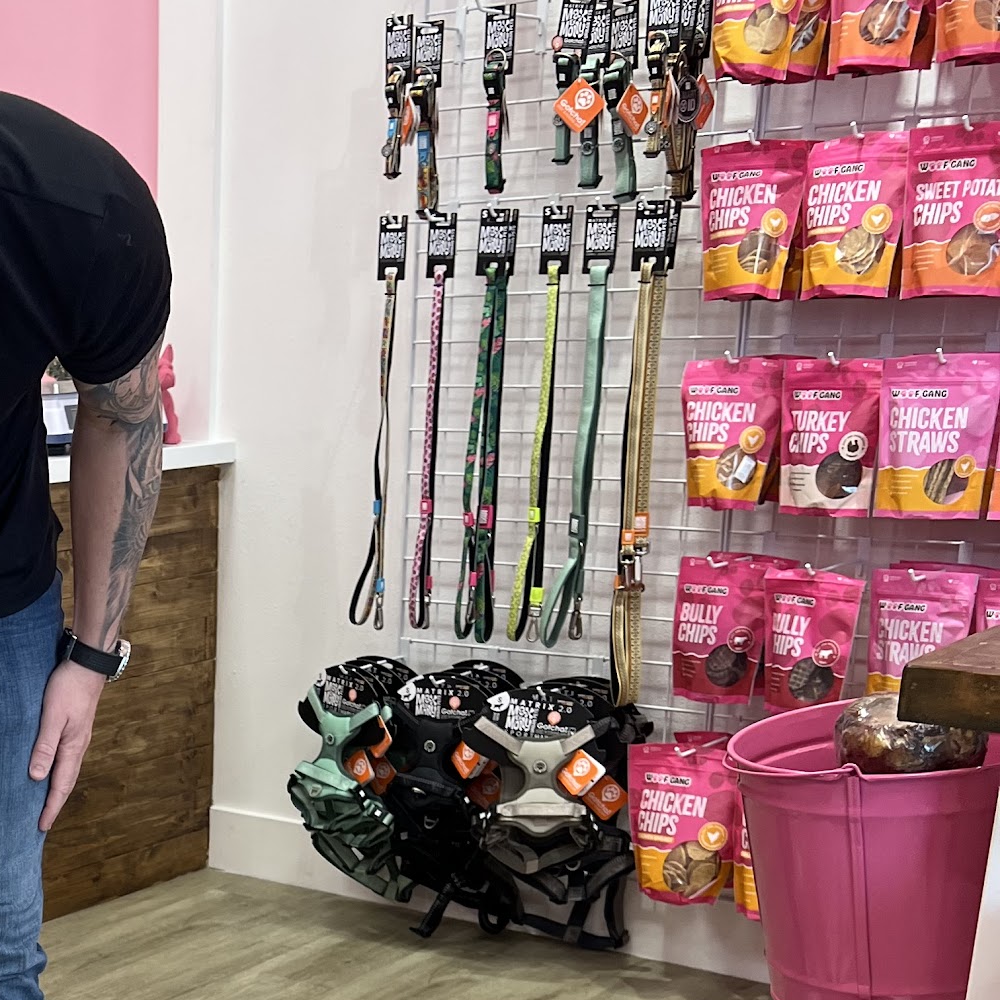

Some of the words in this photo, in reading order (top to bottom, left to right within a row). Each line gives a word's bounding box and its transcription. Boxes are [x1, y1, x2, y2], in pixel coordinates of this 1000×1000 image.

[709, 183, 778, 210] CHICKEN
[808, 179, 882, 207] CHICKEN
[916, 180, 961, 201] SWEET
[708, 205, 751, 232] CHIPS
[806, 202, 852, 229] CHIPS
[913, 201, 963, 227] CHIPS
[686, 401, 757, 423] CHICKEN
[791, 410, 852, 433] TURKEY
[889, 406, 969, 430] CHICKEN
[687, 422, 730, 443] CHIPS
[889, 430, 960, 456] STRAWS
[680, 602, 724, 625] BULLY
[678, 622, 718, 645] CHIPS
[878, 618, 944, 644] CHICKEN
[640, 789, 707, 818] CHICKEN
[638, 811, 679, 836] CHIPS
